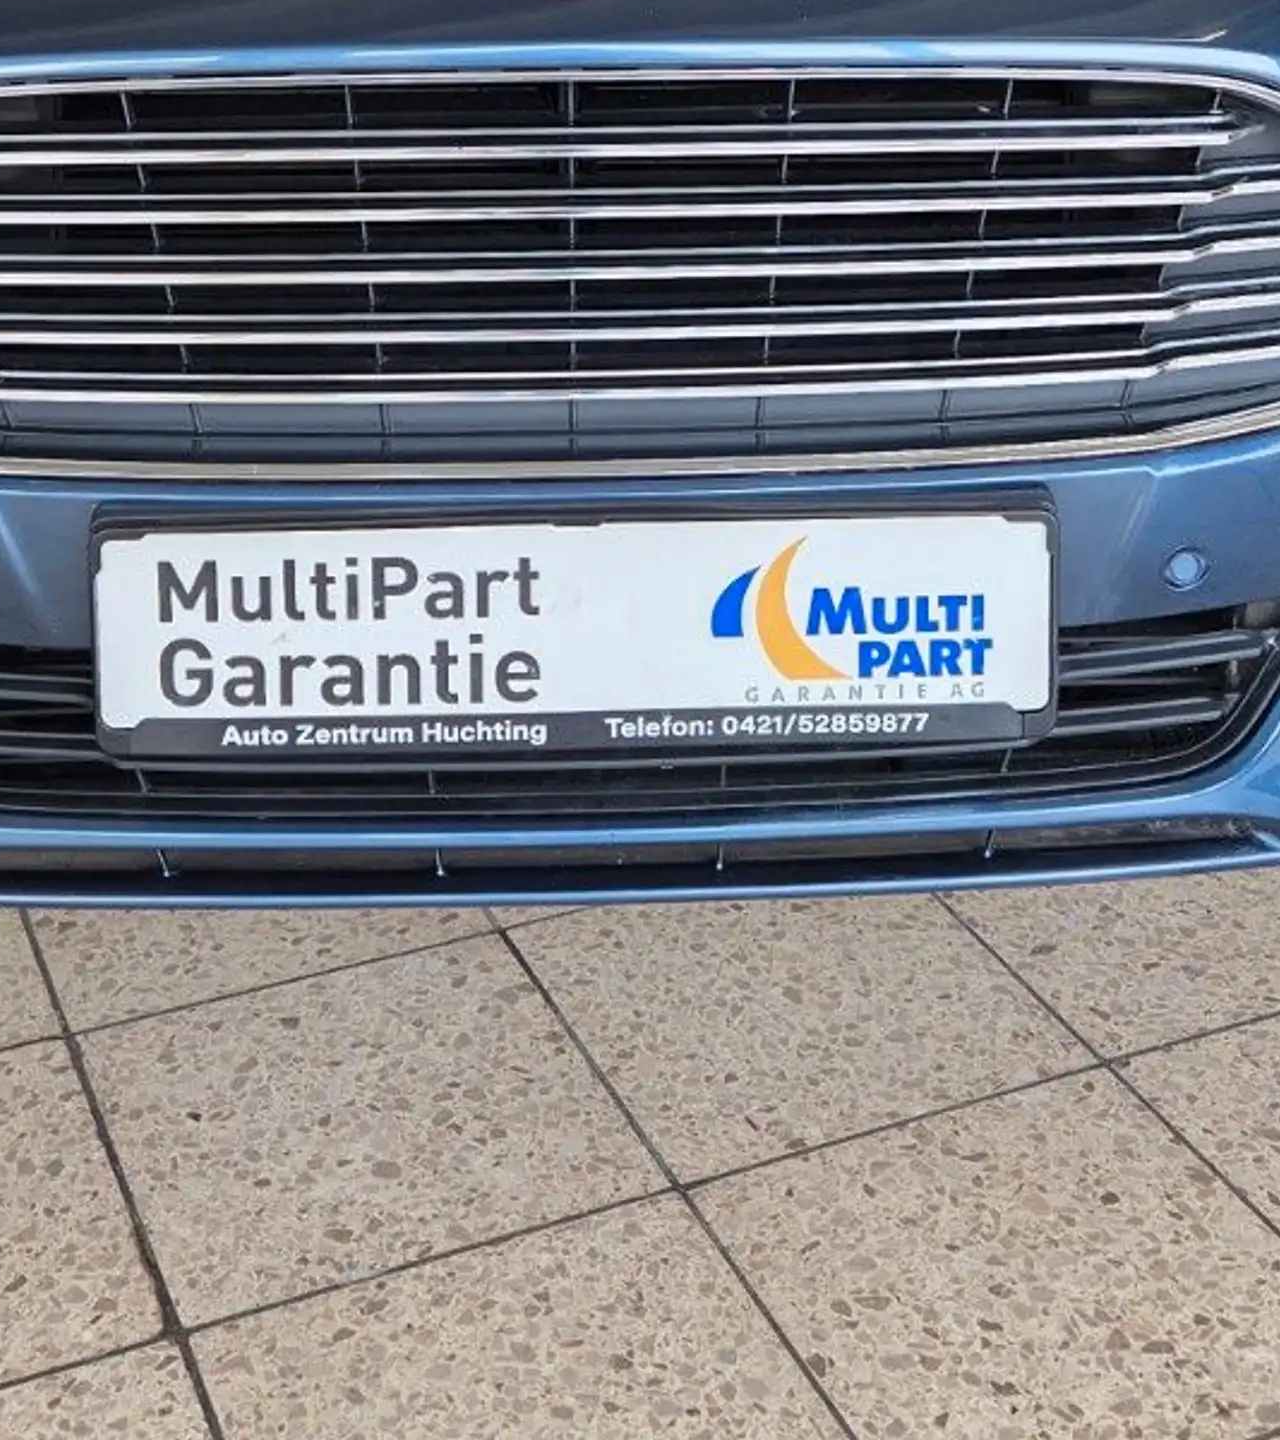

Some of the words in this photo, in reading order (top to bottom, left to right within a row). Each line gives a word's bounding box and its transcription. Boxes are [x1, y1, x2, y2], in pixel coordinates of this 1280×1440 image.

[157, 557, 541, 622] MultiPart
[159, 634, 541, 707] Garantie
[857, 638, 993, 678] PART
[745, 683, 928, 704] GARANTIE
[949, 681, 986, 699] AG
[221, 724, 289, 747] Auto
[295, 723, 414, 746] Zentrum
[422, 719, 549, 744] Huchting
[604, 715, 714, 739] Telefon:
[721, 712, 930, 736] 0421/52859877
